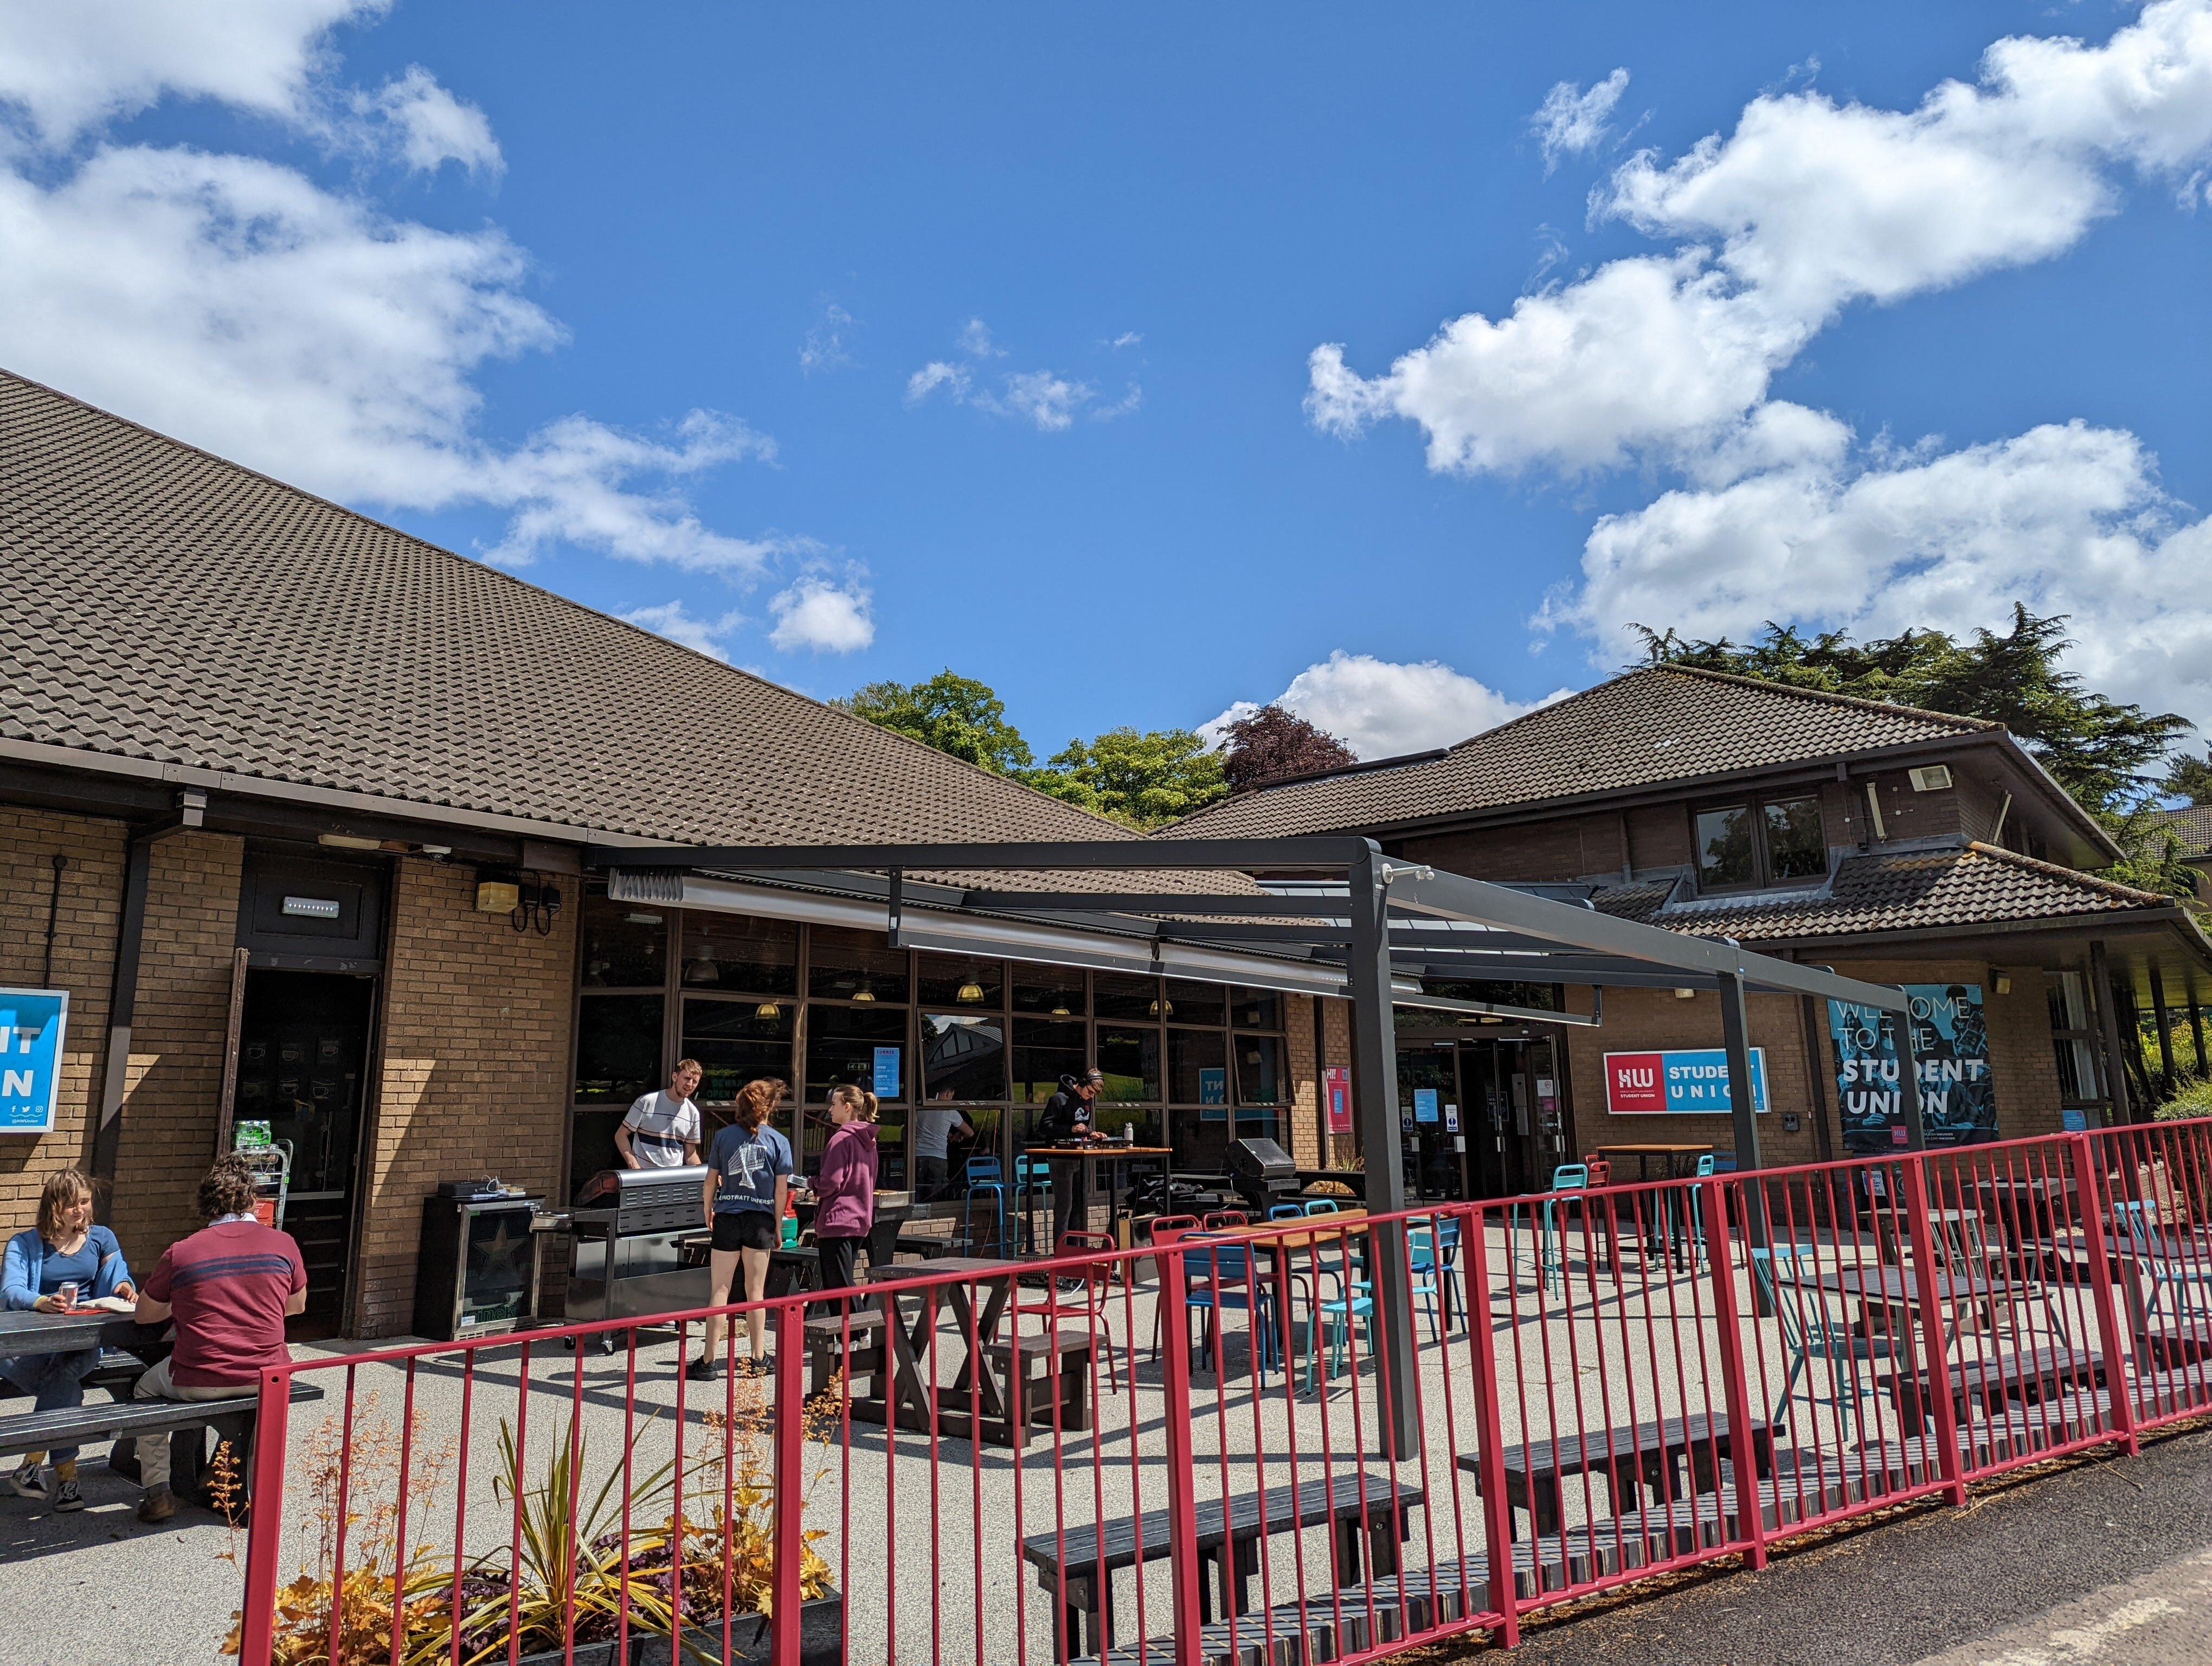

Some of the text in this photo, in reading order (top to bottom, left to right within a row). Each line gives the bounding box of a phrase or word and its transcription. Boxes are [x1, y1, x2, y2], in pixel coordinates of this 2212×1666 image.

[1836, 997, 1970, 1019] WLOME
[1838, 1028, 1876, 1050] TO
[1669, 1065, 1754, 1079] STUDE
[1671, 1084, 1756, 1098] UNI
